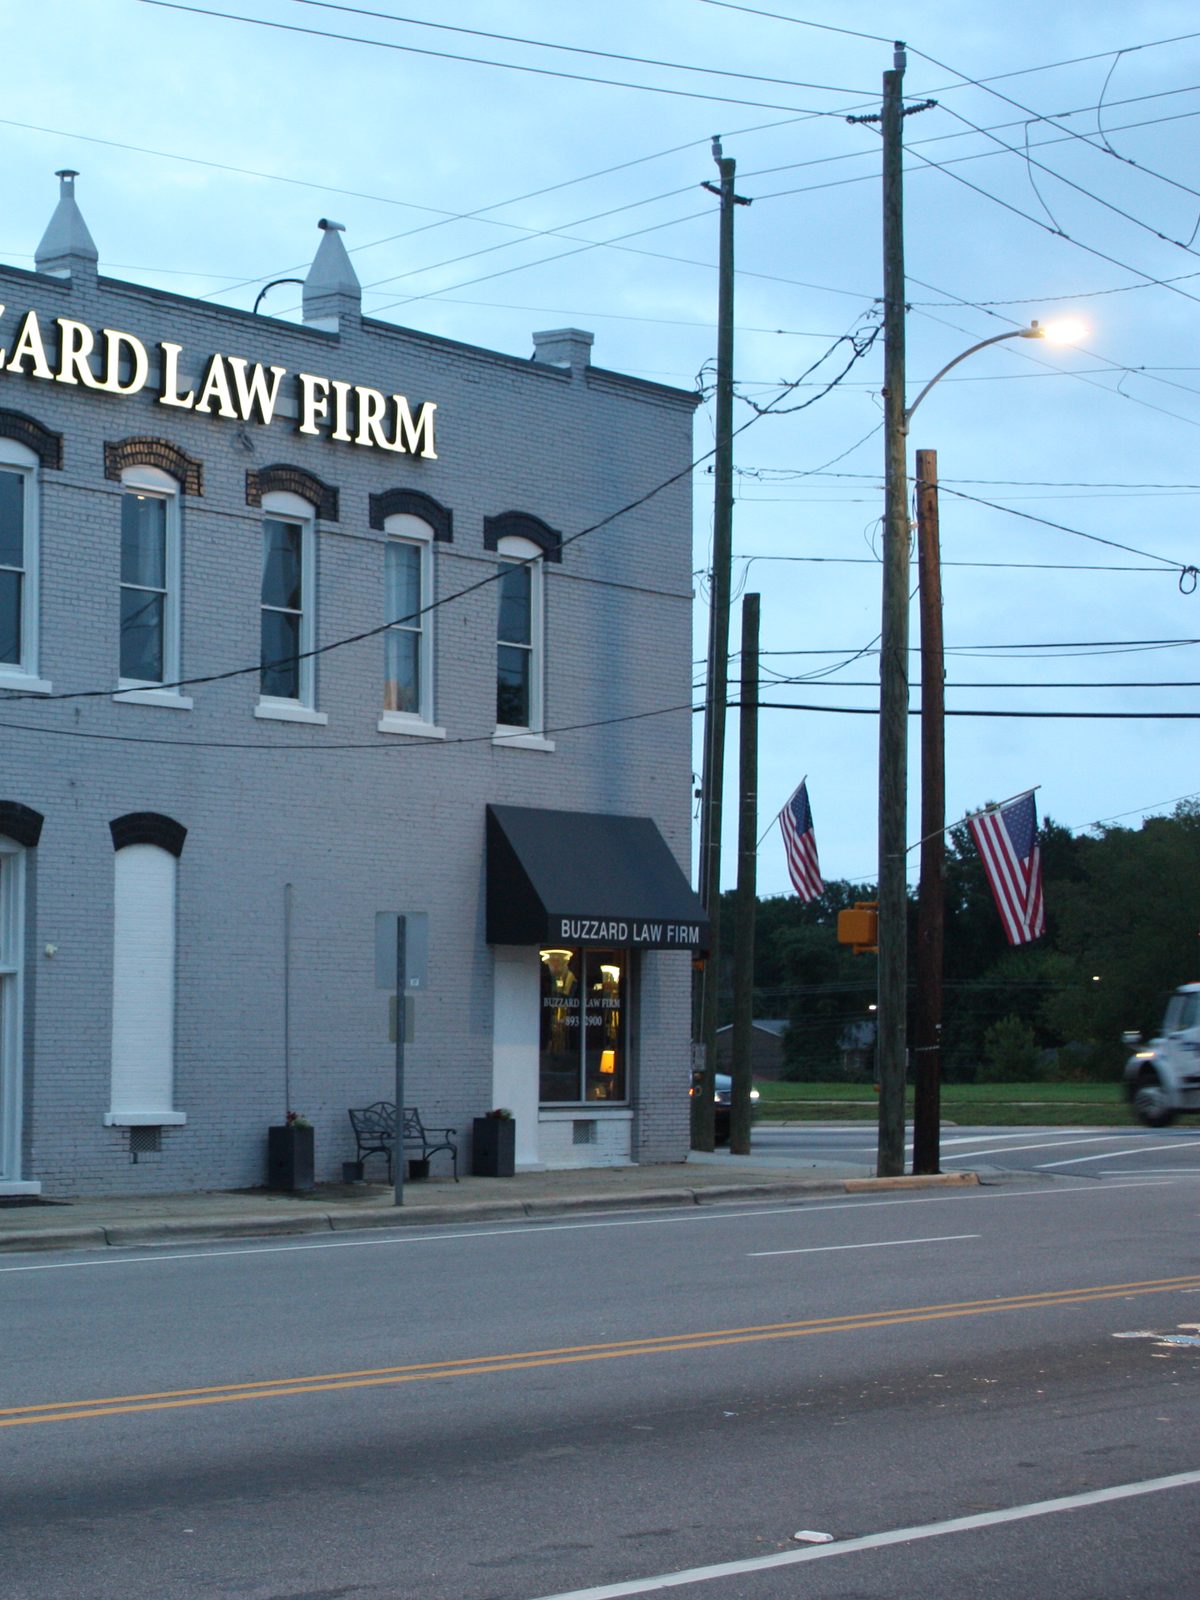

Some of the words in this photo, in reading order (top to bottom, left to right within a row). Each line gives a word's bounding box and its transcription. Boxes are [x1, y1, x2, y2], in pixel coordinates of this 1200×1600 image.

[158, 341, 286, 426] LAW
[297, 373, 439, 460] FIRM
[561, 919, 628, 941] BUZZARD
[633, 923, 662, 942] LAW
[667, 925, 699, 944] FIRM
[543, 997, 580, 1008] BUZZARD
[601, 998, 620, 1008] FIRM
